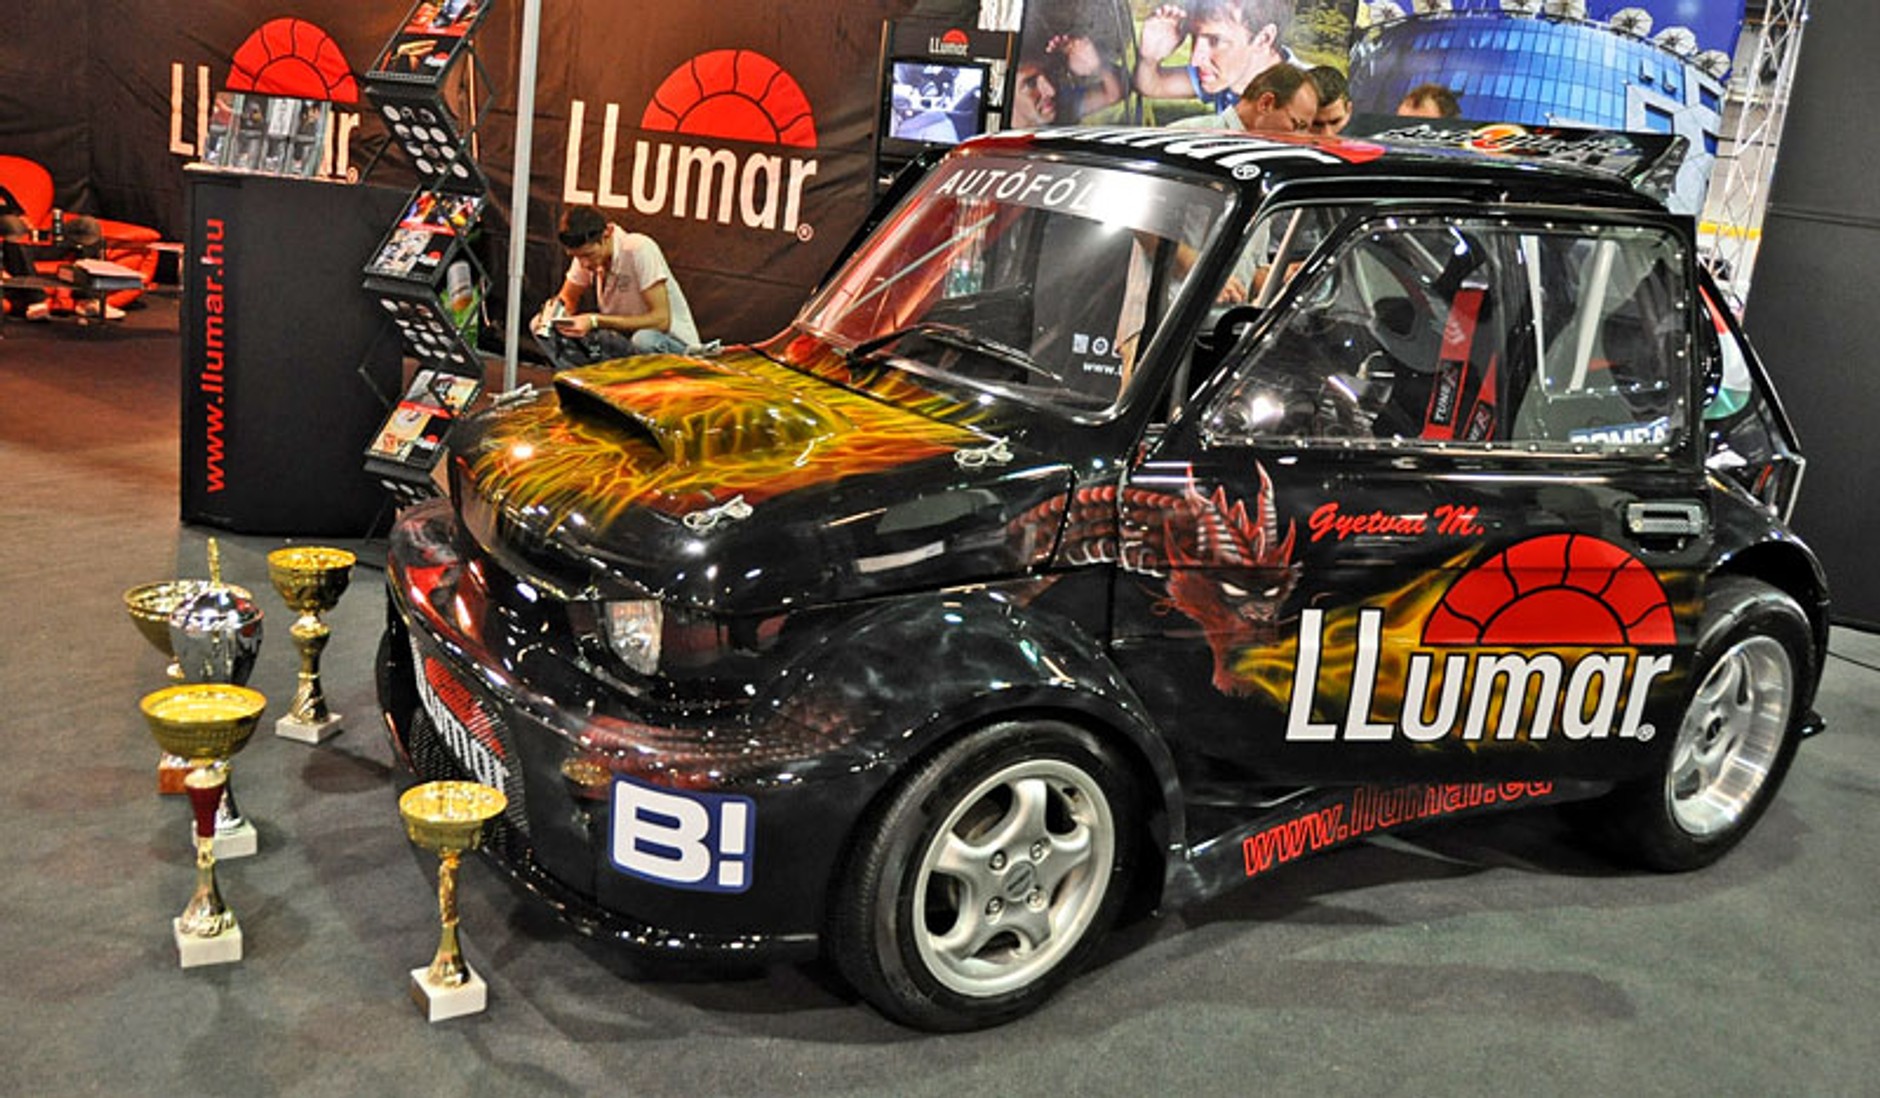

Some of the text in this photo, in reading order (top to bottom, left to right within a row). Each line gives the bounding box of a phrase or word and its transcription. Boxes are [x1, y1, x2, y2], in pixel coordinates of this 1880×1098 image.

[563, 100, 818, 233] LLumar
[201, 218, 225, 493] www.llumar.hu
[1433, 502, 1485, 535] M.
[1285, 608, 1673, 742] LLumar
[613, 780, 747, 887] B!
